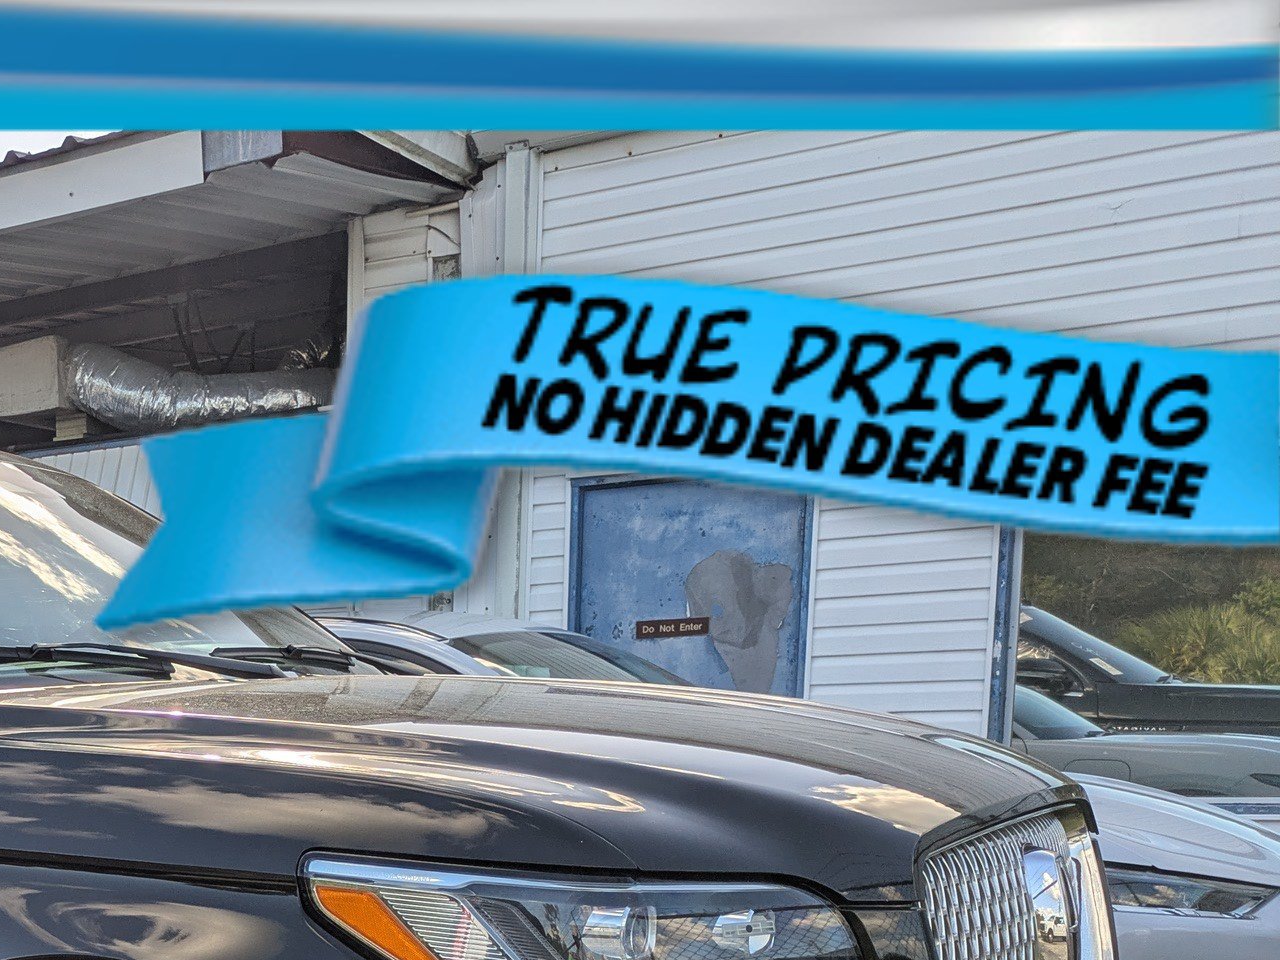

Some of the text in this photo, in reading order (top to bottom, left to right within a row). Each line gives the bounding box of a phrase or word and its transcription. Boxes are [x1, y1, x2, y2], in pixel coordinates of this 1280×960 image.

[642, 622, 703, 634] Do Not Enter
